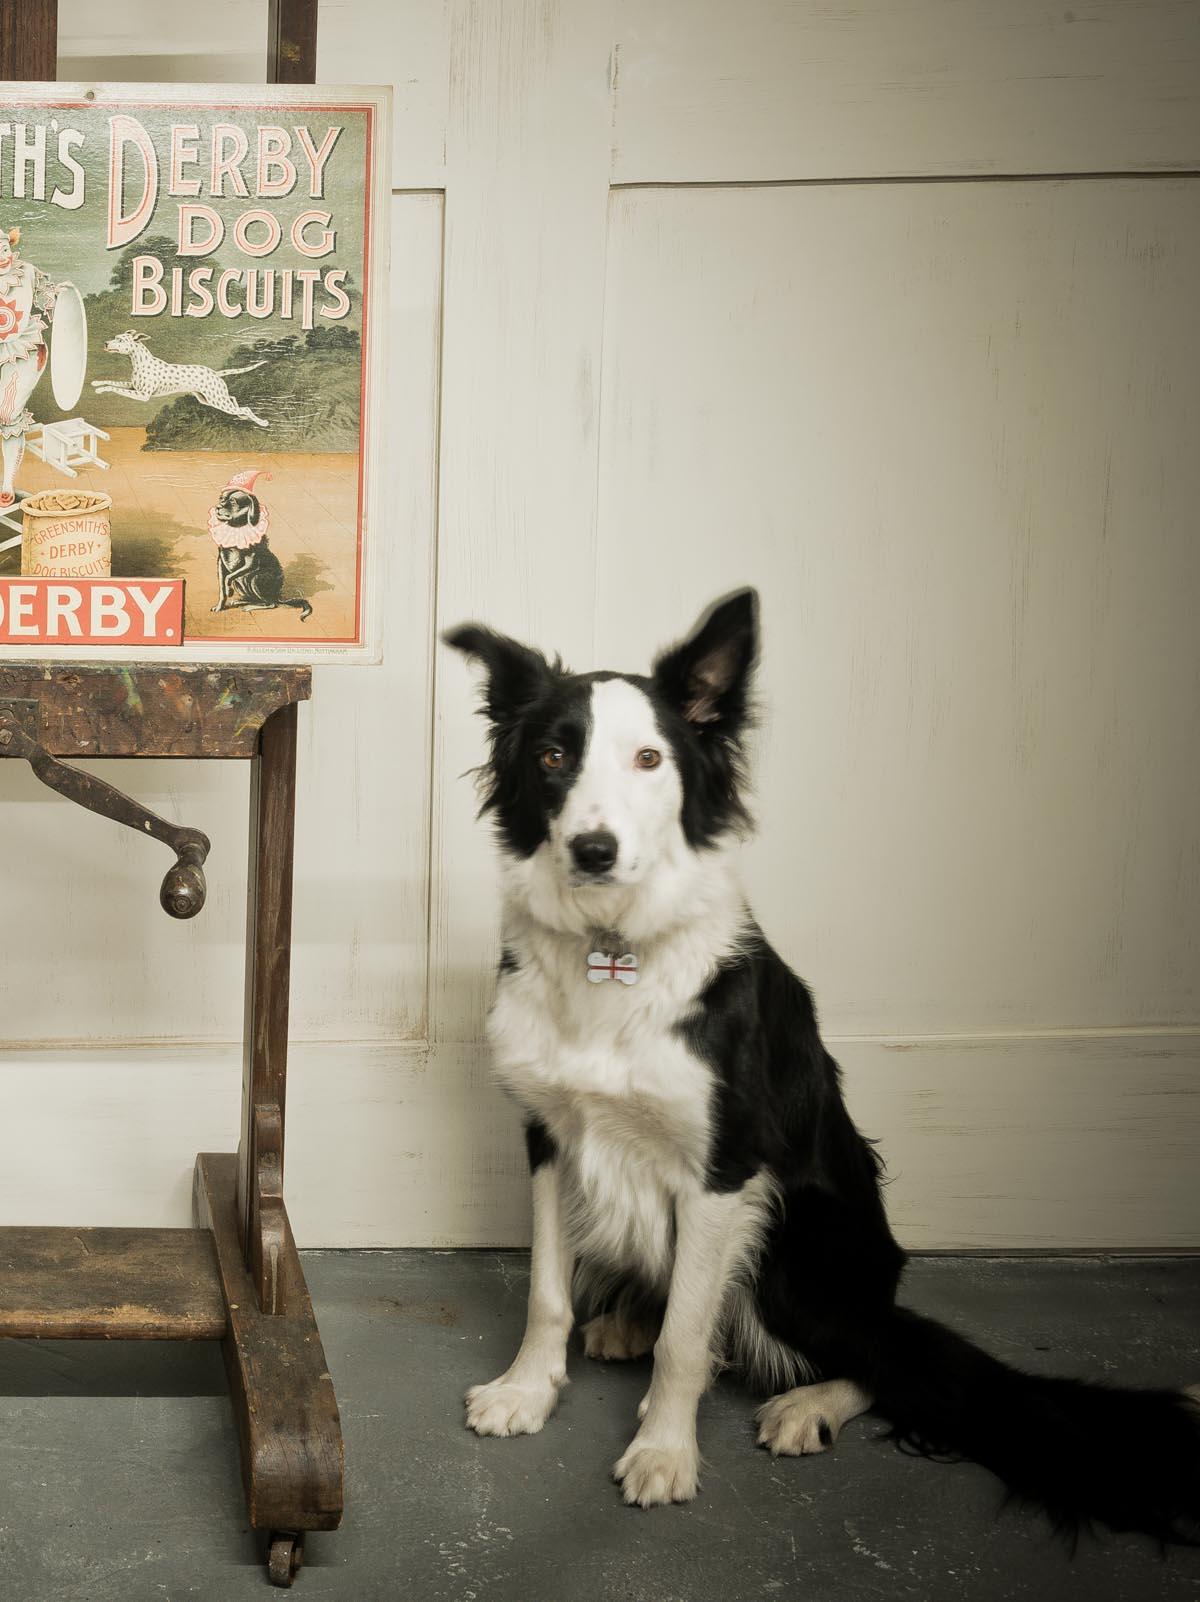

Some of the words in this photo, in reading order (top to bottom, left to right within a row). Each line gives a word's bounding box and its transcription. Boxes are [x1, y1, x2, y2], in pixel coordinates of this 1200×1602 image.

[106, 114, 345, 250] DERBY
[176, 203, 337, 258] DOG
[131, 255, 351, 330] BISCUITS
[34, 521, 108, 544] GREENSMITH'S
[49, 541, 94, 559] DERBY
[34, 563, 56, 577] DOG
[60, 556, 110, 577] BISCUITS
